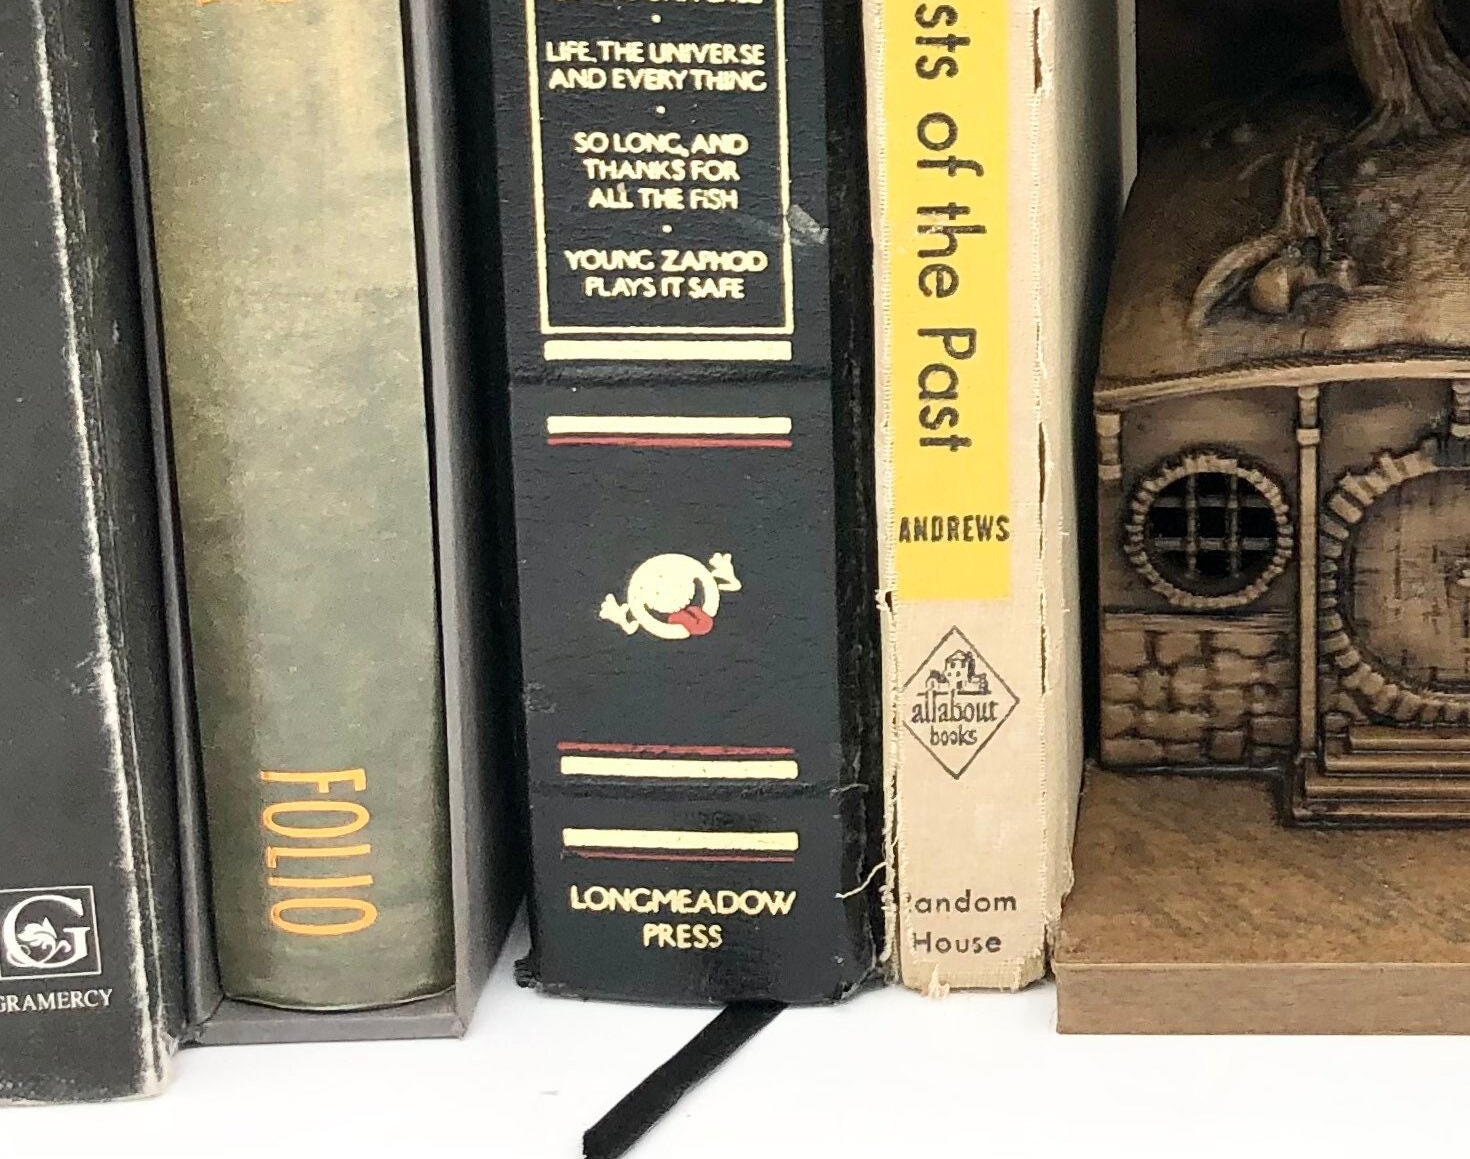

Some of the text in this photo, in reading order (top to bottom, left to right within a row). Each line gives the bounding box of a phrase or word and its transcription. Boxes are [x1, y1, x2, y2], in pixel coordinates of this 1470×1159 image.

[600, 41, 645, 63] THE
[649, 43, 765, 66] UNIVERSE
[549, 69, 768, 92] AND EVERYTHING
[574, 131, 749, 158] SO LONG, AND
[917, 111, 984, 177] of
[583, 159, 741, 182] THANKS FOR
[588, 187, 738, 210] ALL THE FISH
[564, 249, 769, 272] YOUNG ZAPHOD
[917, 202, 987, 299] the
[584, 277, 745, 299] PLAYS IT SAFE
[917, 327, 977, 453] Past
[899, 514, 1011, 543] ANDREWS
[929, 725, 978, 747] books
[260, 768, 378, 936] FOLIO
[569, 884, 797, 917] LONGMEADOW
[904, 888, 1017, 914] andom
[642, 923, 723, 950] PRESS
[913, 931, 1002, 954] House
